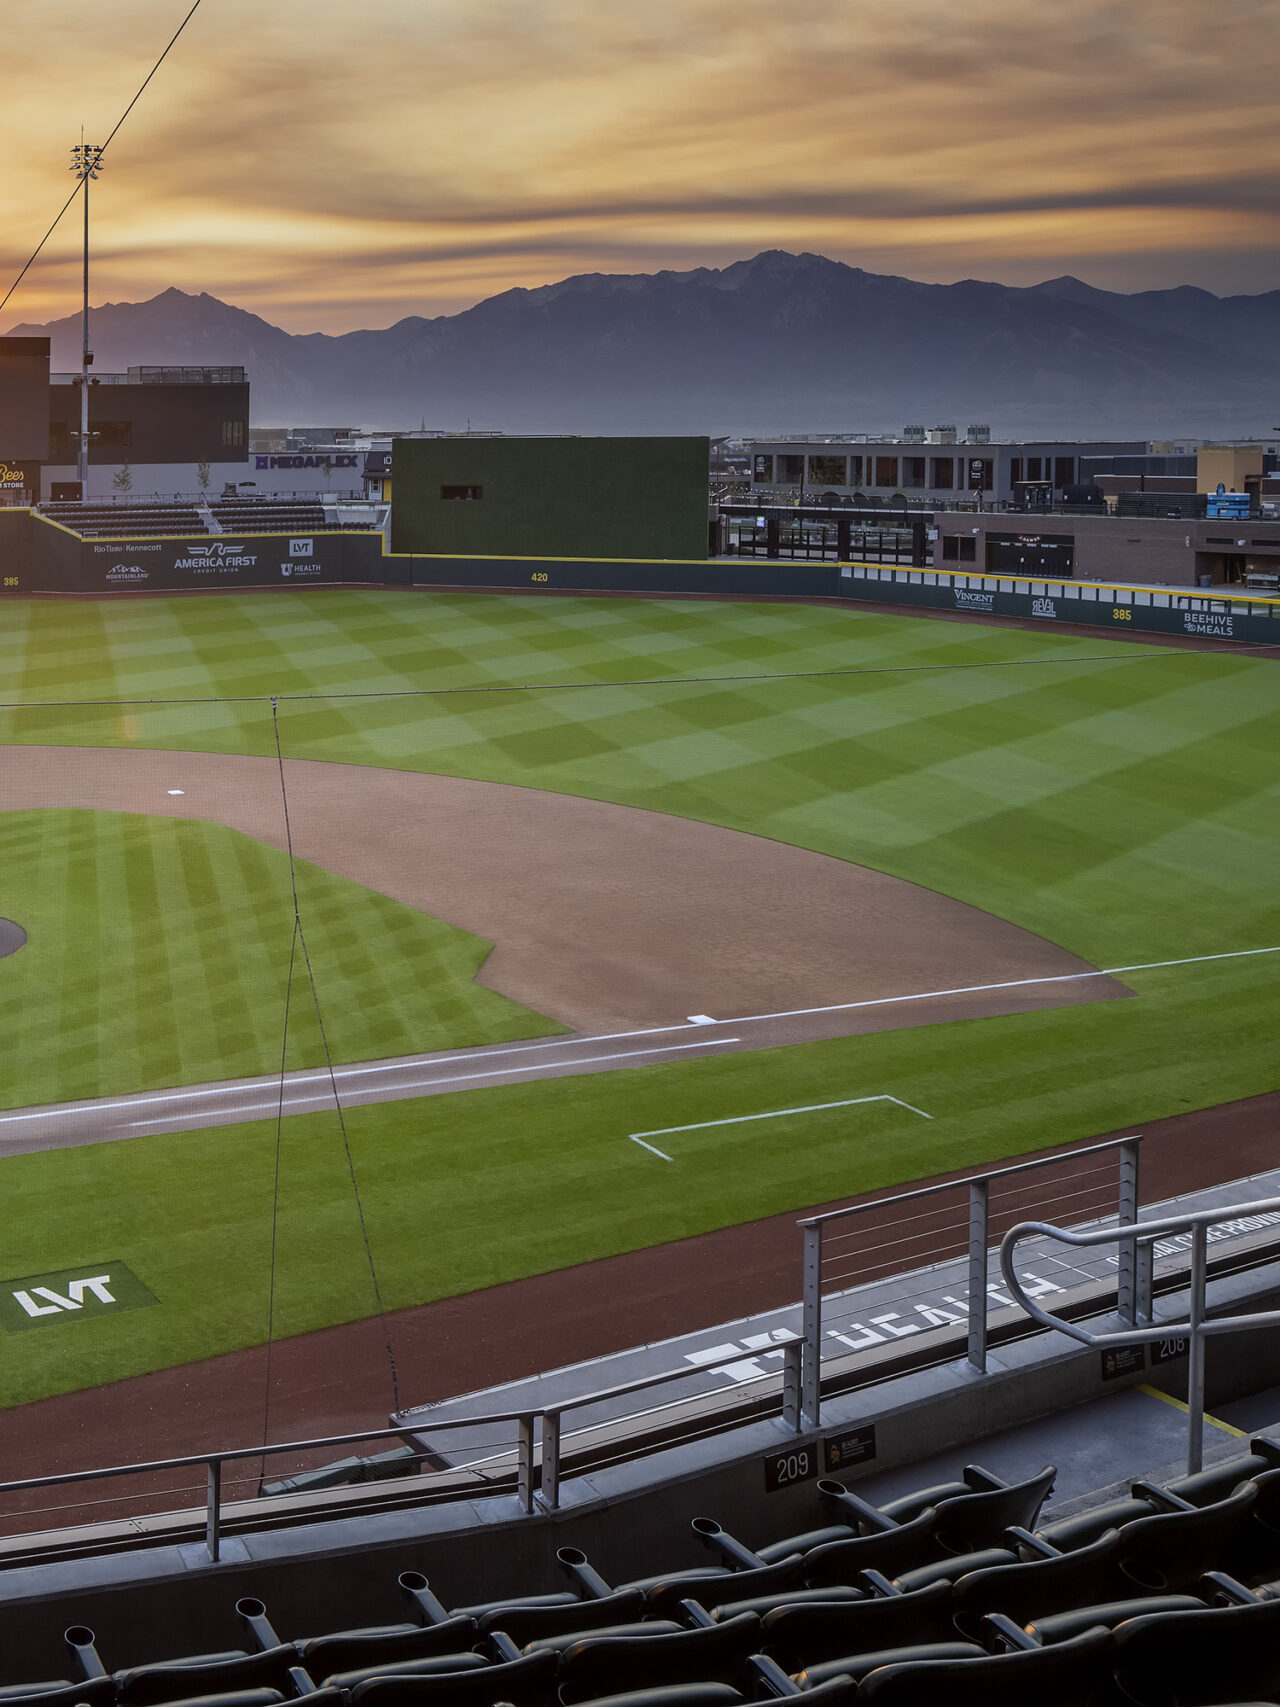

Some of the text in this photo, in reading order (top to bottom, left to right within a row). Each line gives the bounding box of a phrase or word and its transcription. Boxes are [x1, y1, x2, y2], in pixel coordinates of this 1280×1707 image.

[270, 455, 358, 469] MEGAPLEX
[125, 544, 162, 552] Kennecott
[293, 543, 310, 552] LVT
[174, 556, 258, 569] AMERICA FIRST
[294, 564, 321, 572] HEALTH
[3, 576, 19, 586] 385
[531, 572, 548, 582] 420
[1112, 608, 1132, 621] 385
[1184, 612, 1233, 626] BEEHIVE
[1196, 625, 1233, 636] MEALS
[11, 1274, 117, 1318] LVT
[777, 1451, 809, 1484] 209
